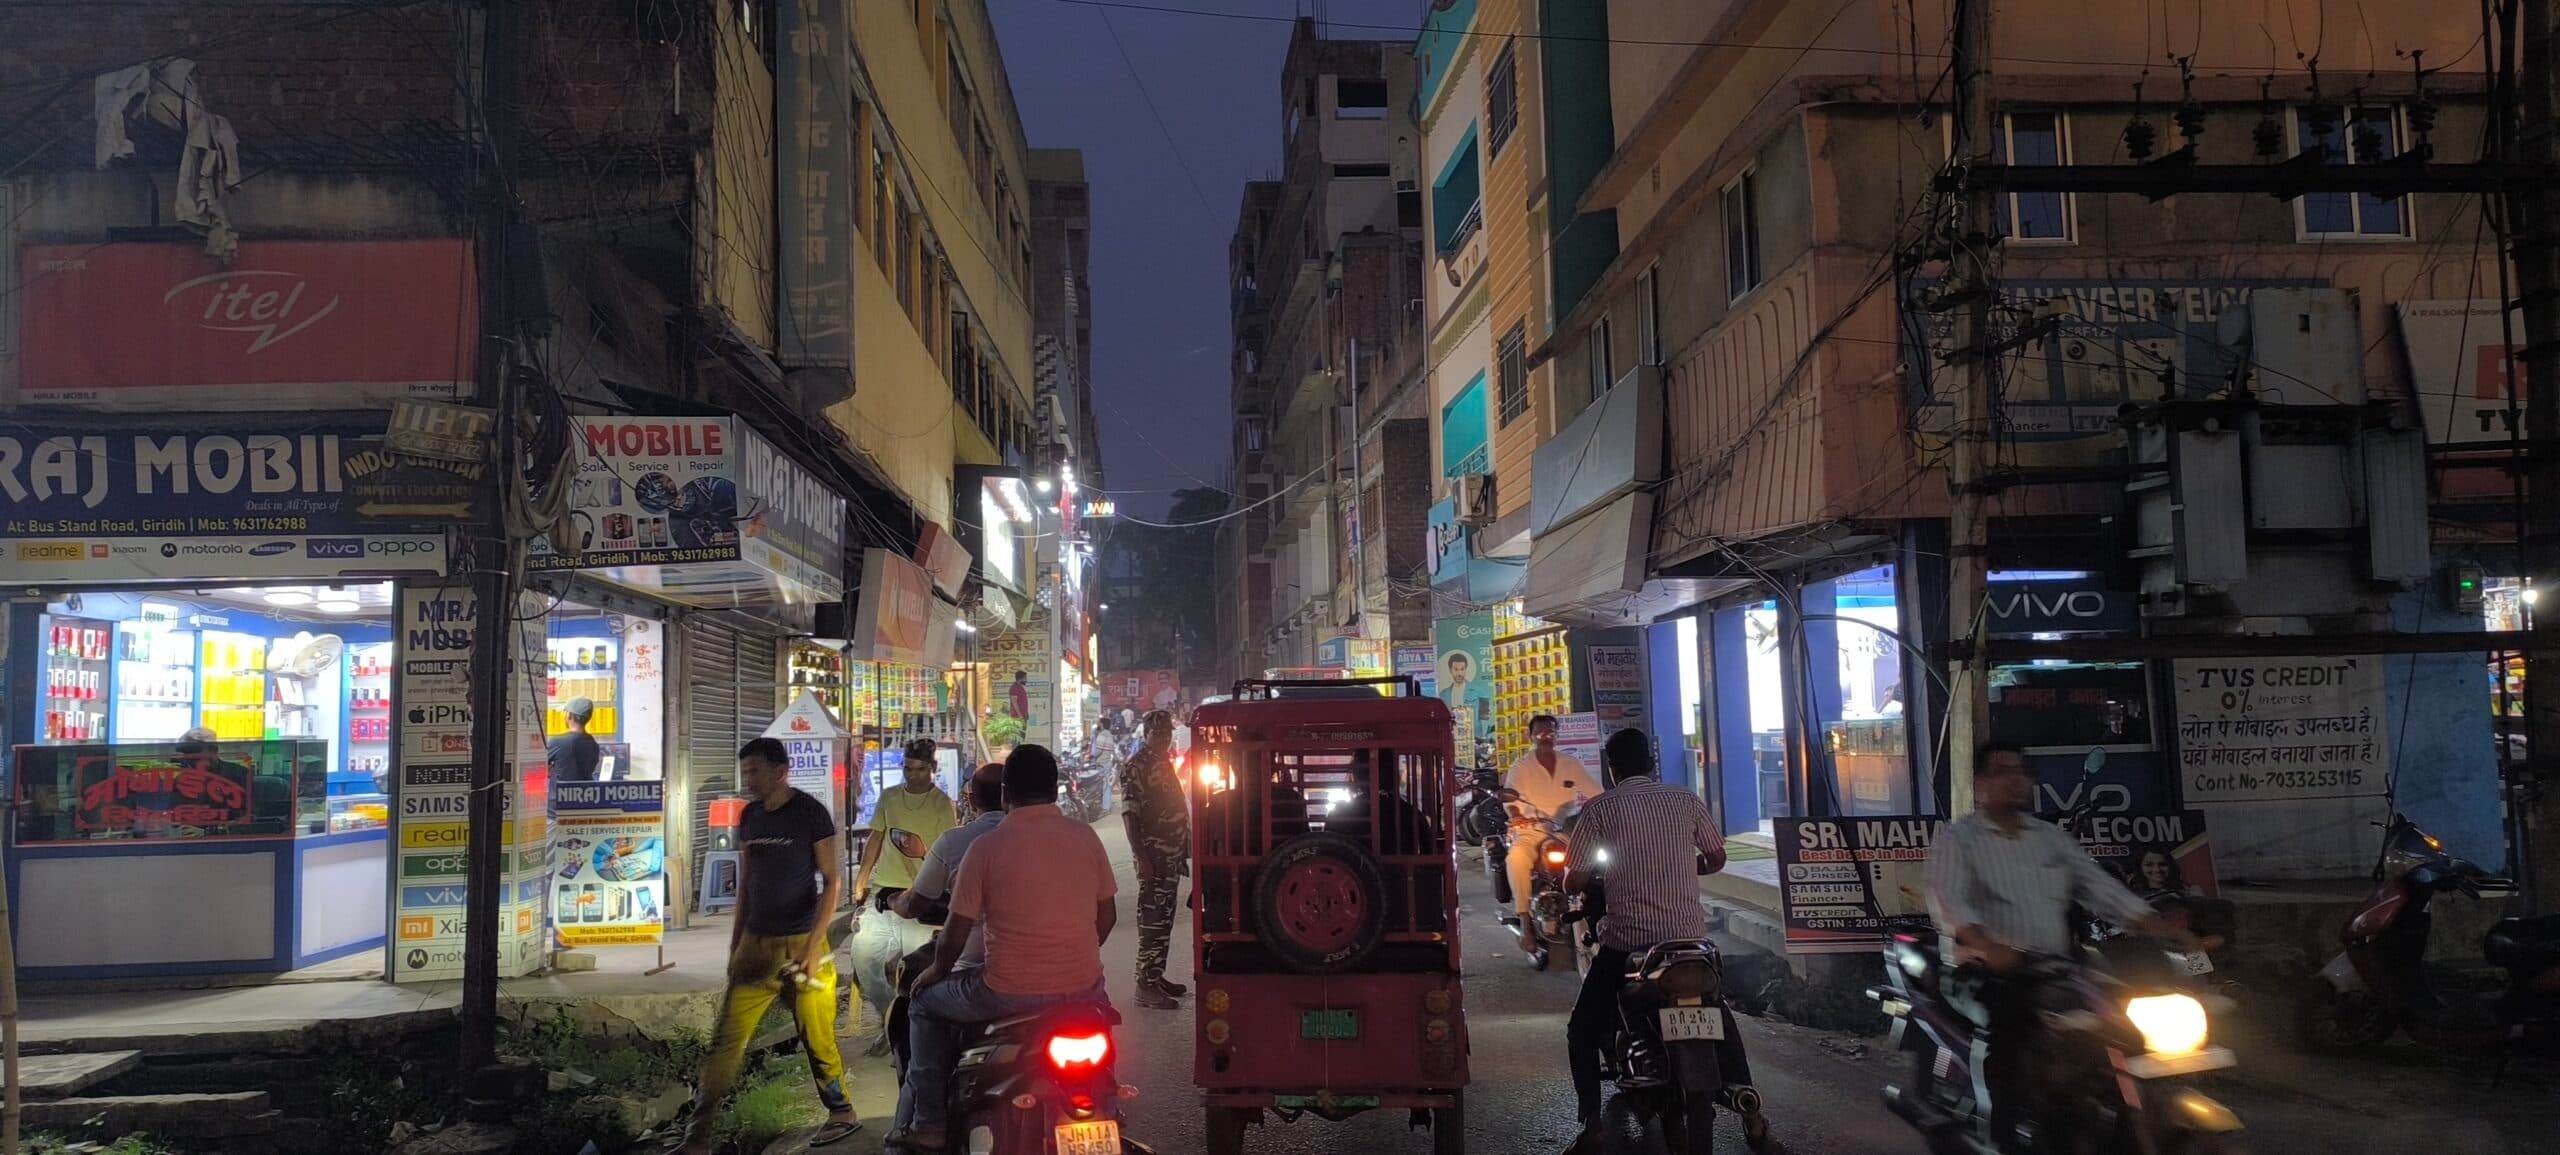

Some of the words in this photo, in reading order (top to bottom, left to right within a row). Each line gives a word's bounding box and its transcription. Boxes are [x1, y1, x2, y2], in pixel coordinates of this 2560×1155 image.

[204, 280, 305, 320] itel
[587, 424, 722, 457] MOBILE
[344, 450, 396, 479] INDO
[580, 462, 608, 473] Sale
[628, 461, 669, 472] Service
[689, 461, 724, 473] Repair
[744, 430, 790, 524] NIRAJ
[792, 464, 838, 543] MOBILE
[7, 520, 25, 533] At:
[29, 520, 54, 533] Bus
[60, 520, 97, 533] Stand
[101, 520, 138, 534] Road,
[142, 519, 185, 532] Giridih
[198, 519, 229, 532] Mob:
[232, 518, 307, 531] 9631762988
[22, 543, 78, 557] realme
[182, 543, 243, 555] motorola
[312, 543, 360, 554] vivo
[367, 540, 435, 556] oppo
[589, 553, 630, 566] Giridih
[640, 550, 669, 564] Mob:
[671, 546, 737, 562] 9631762988
[1986, 584, 2105, 619] vivo
[410, 661, 451, 673] MOBILE
[2198, 667, 2255, 688] TVS
[2262, 665, 2350, 687] CREDIT
[2221, 688, 2253, 714] 0%
[429, 705, 511, 723] iPhe
[2181, 714, 2212, 739] लोन
[787, 755, 828, 769] OBILE
[416, 768, 472, 784] NOTH
[2195, 770, 2233, 792] Cont
[557, 786, 600, 804] NIRAJ
[605, 785, 661, 801] MOBILE
[2032, 783, 2131, 813] ivo
[591, 827, 621, 835] SERVICE
[627, 825, 653, 833] REPAIR
[1801, 849, 1834, 860] Best
[1836, 849, 1875, 860] Deals
[1791, 884, 1862, 893] SAMSUNG
[1792, 895, 1844, 903] Finance+
[1820, 909, 1857, 917] CREDIT
[405, 922, 428, 934] mi
[1807, 919, 1845, 928] GSTIN
[1067, 1124, 1111, 1143] JH11A
